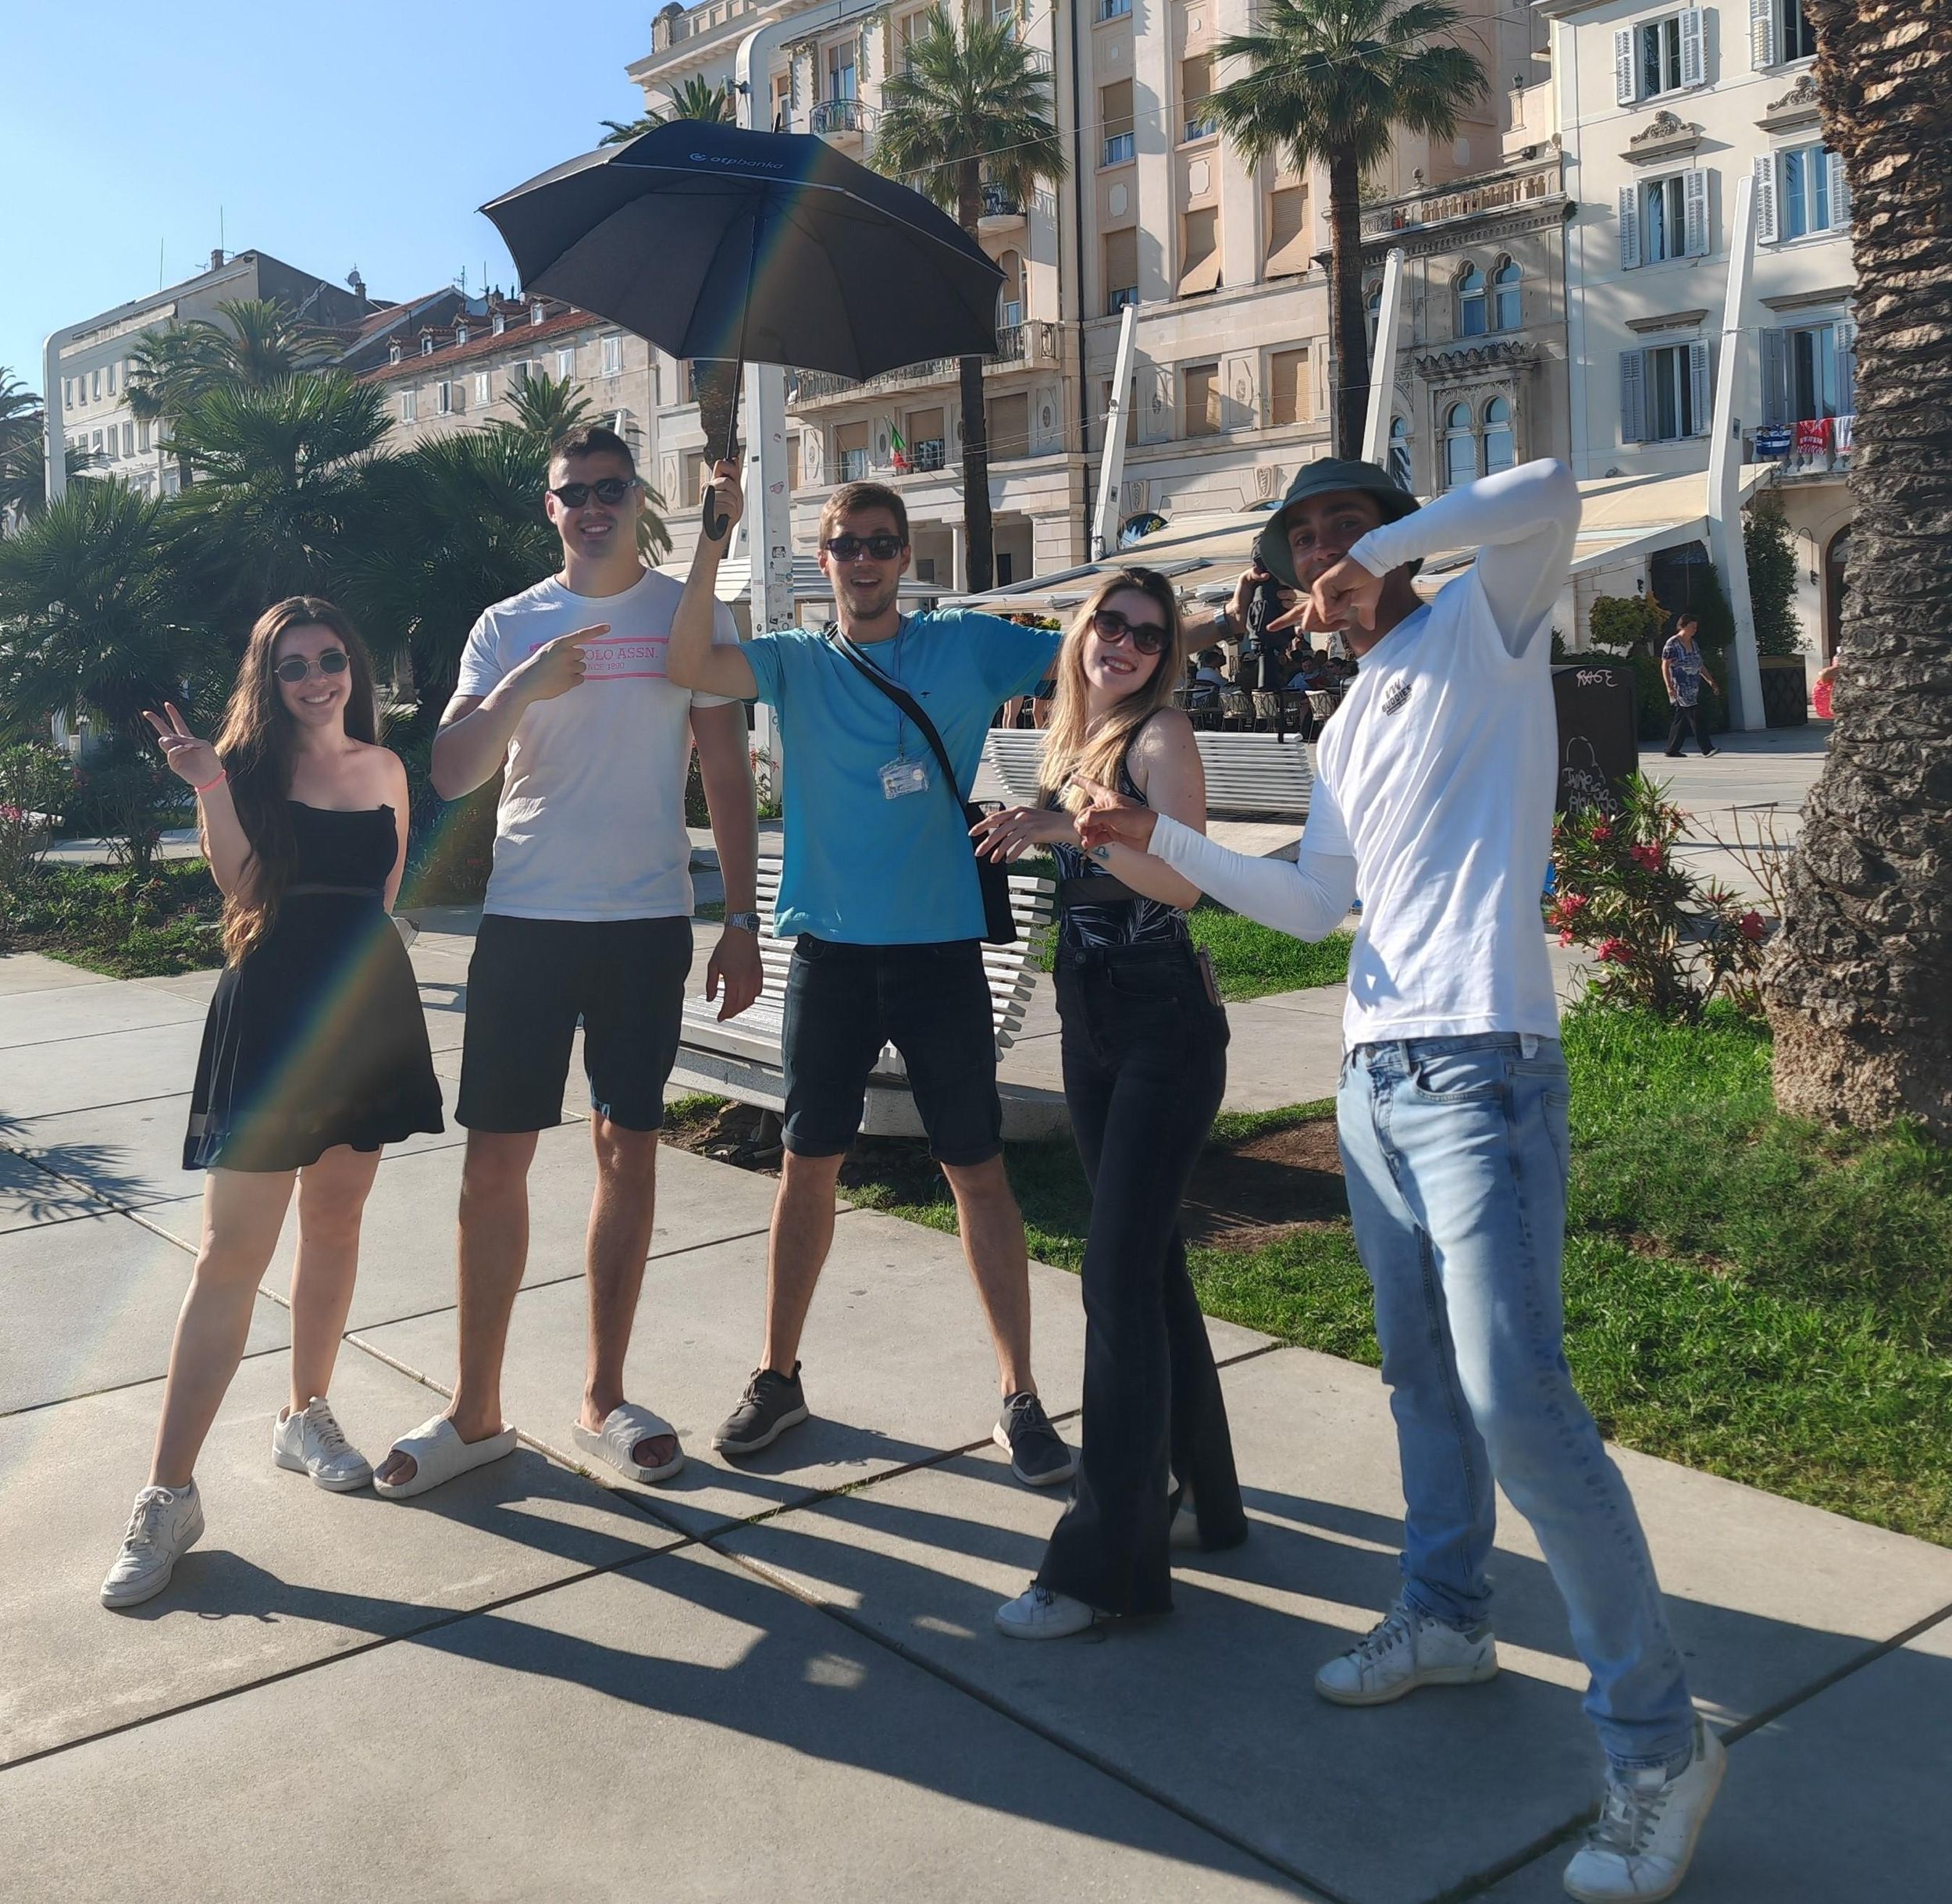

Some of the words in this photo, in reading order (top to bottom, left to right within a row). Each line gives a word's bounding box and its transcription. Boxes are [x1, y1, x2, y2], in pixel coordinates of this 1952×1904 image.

[710, 157, 783, 169] otpbanka
[586, 649, 613, 661] OLO
[618, 647, 658, 659] ASSN.
